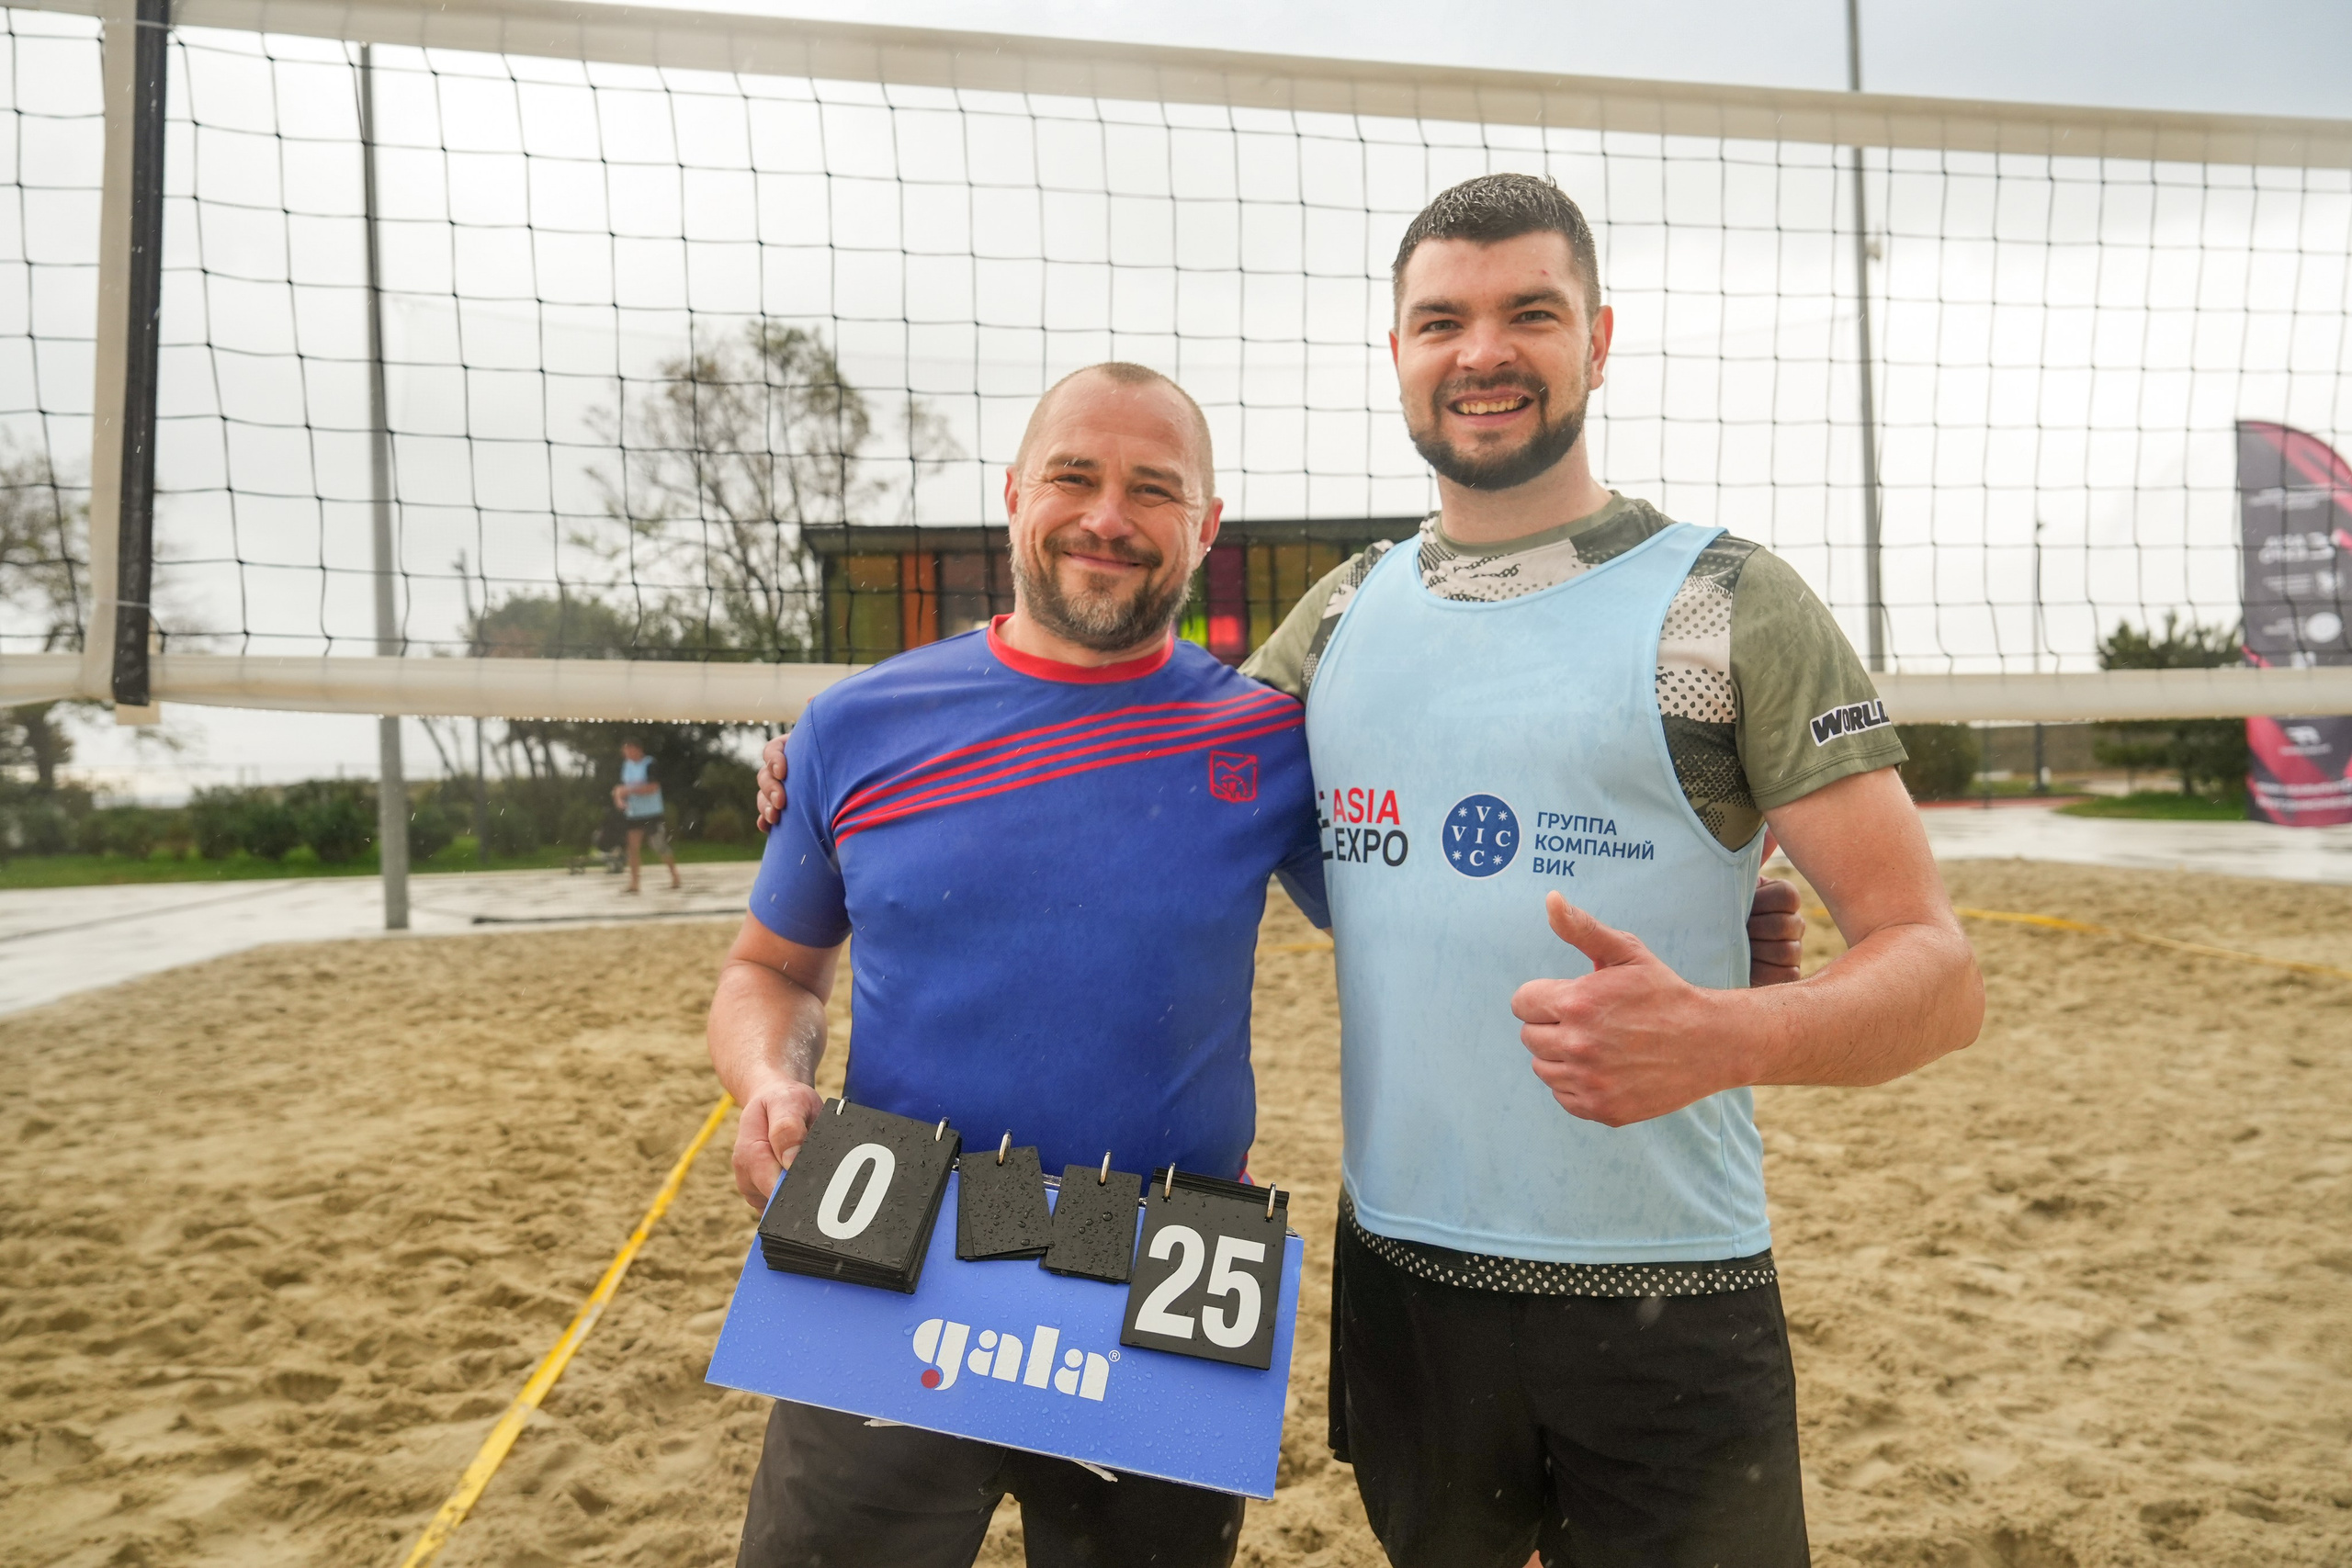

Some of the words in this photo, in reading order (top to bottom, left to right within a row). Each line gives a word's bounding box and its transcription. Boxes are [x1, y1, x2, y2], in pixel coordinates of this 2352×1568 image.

[1333, 787, 1400, 825] ASIA
[1537, 811, 1617, 836] ГРУППА
[1334, 828, 1408, 867] EXPO
[1534, 833, 1654, 860] КОМПАНИЙ
[1532, 857, 1575, 877] ВИК
[817, 1143, 896, 1240] 0
[1134, 1224, 1266, 1348] 25
